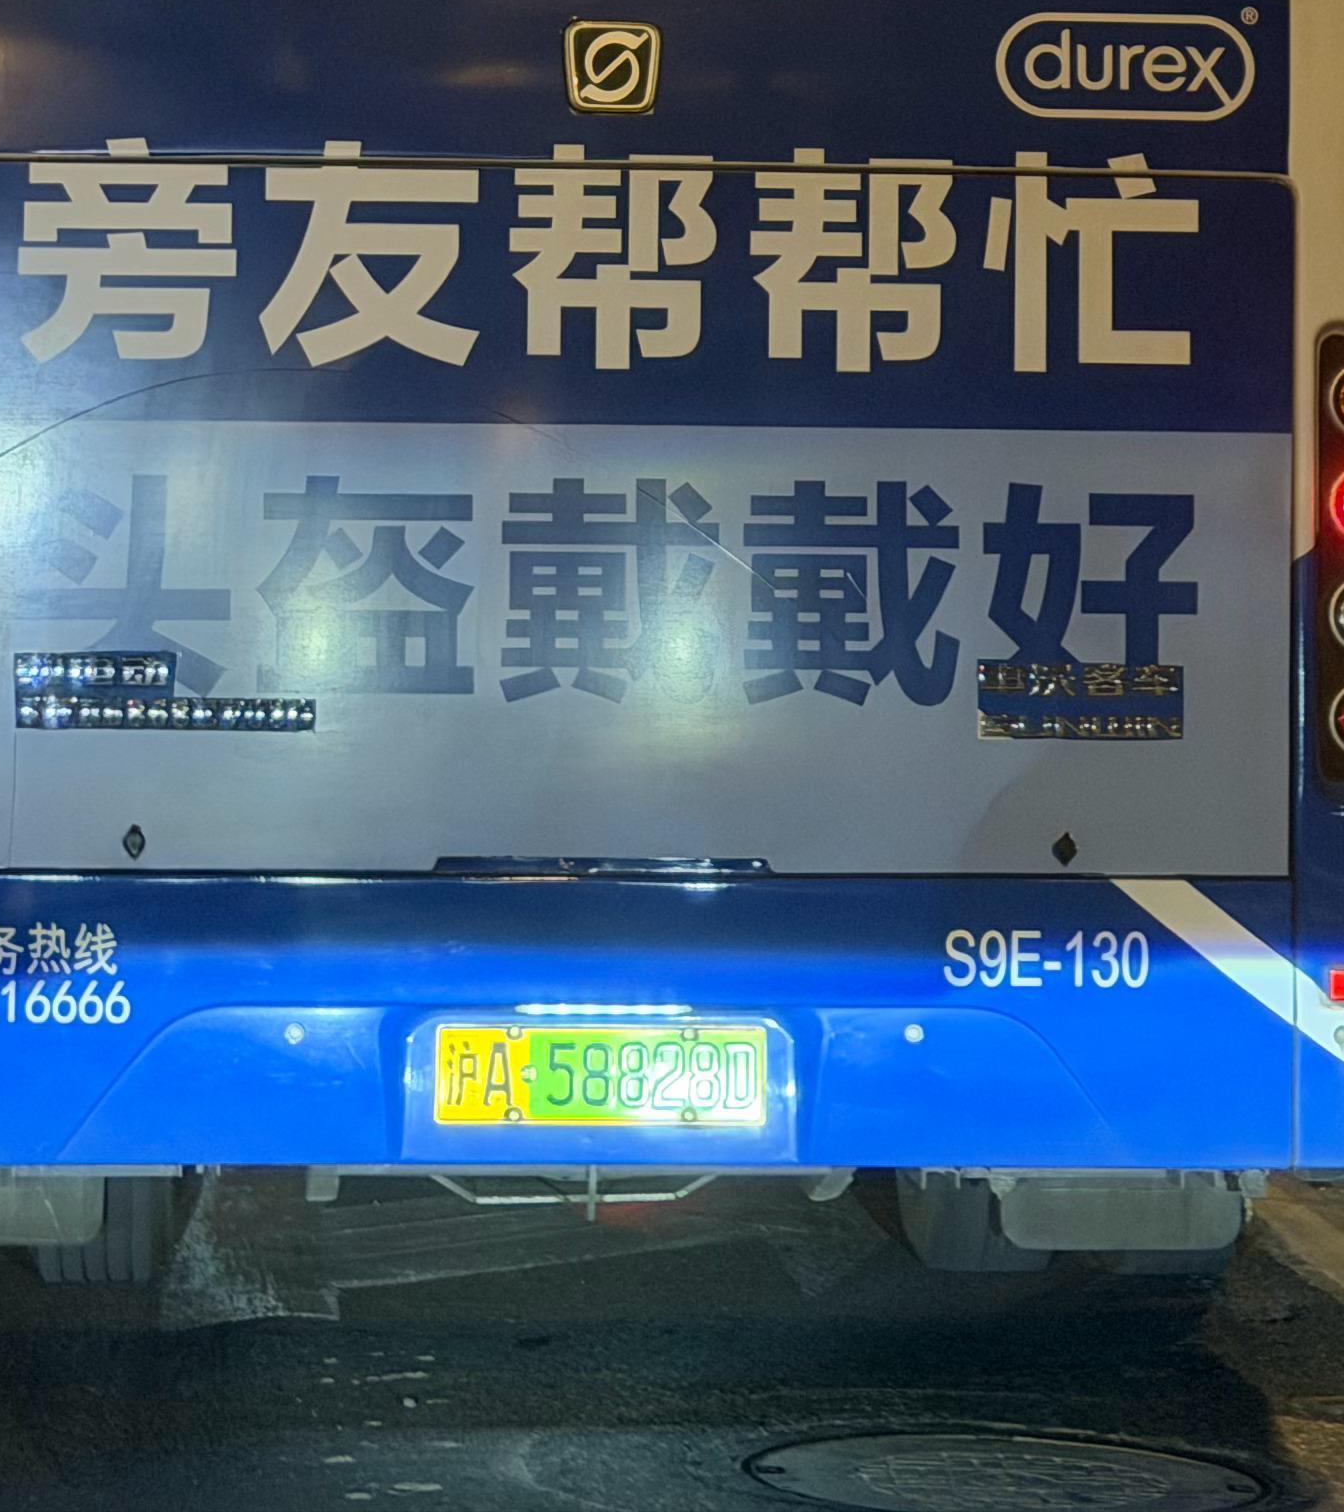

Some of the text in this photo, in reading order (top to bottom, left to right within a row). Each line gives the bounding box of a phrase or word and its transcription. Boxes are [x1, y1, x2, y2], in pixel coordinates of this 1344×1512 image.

[1024, 28, 1233, 106] durex
[17, 137, 1200, 373] 旁友帮帮忙
[13, 473, 1199, 707] 头盔戴戴好
[943, 928, 1150, 989] S9E-130
